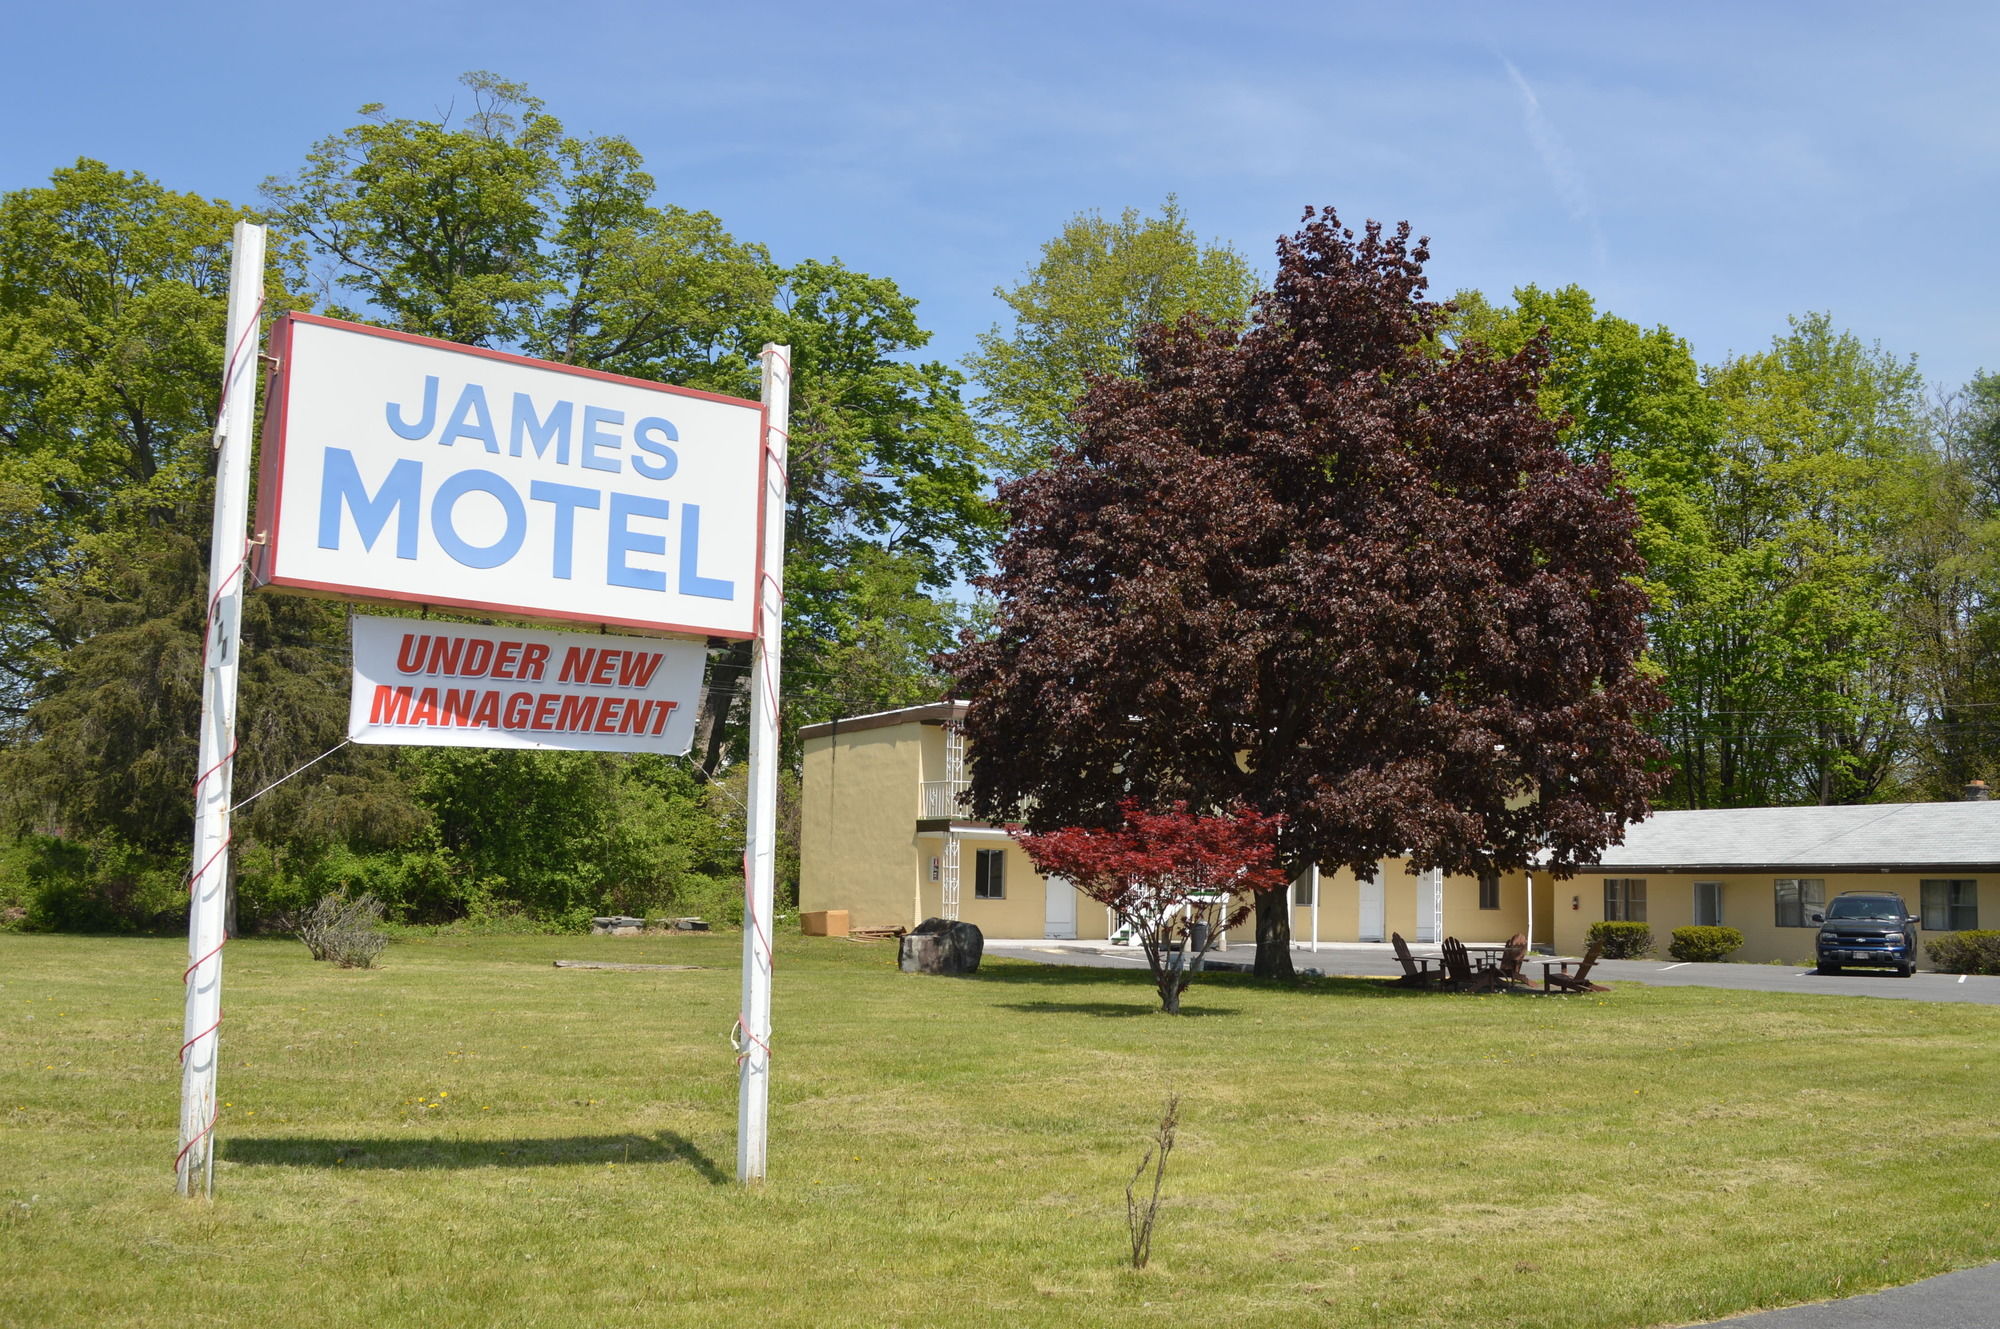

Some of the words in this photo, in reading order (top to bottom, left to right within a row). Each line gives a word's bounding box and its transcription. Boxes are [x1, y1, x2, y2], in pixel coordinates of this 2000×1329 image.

[386, 375, 678, 480] JAMES
[318, 446, 734, 600] MOTEL
[396, 634, 550, 680] UNDER
[558, 647, 663, 687] NEW
[369, 684, 678, 735] MANAGEMENT
